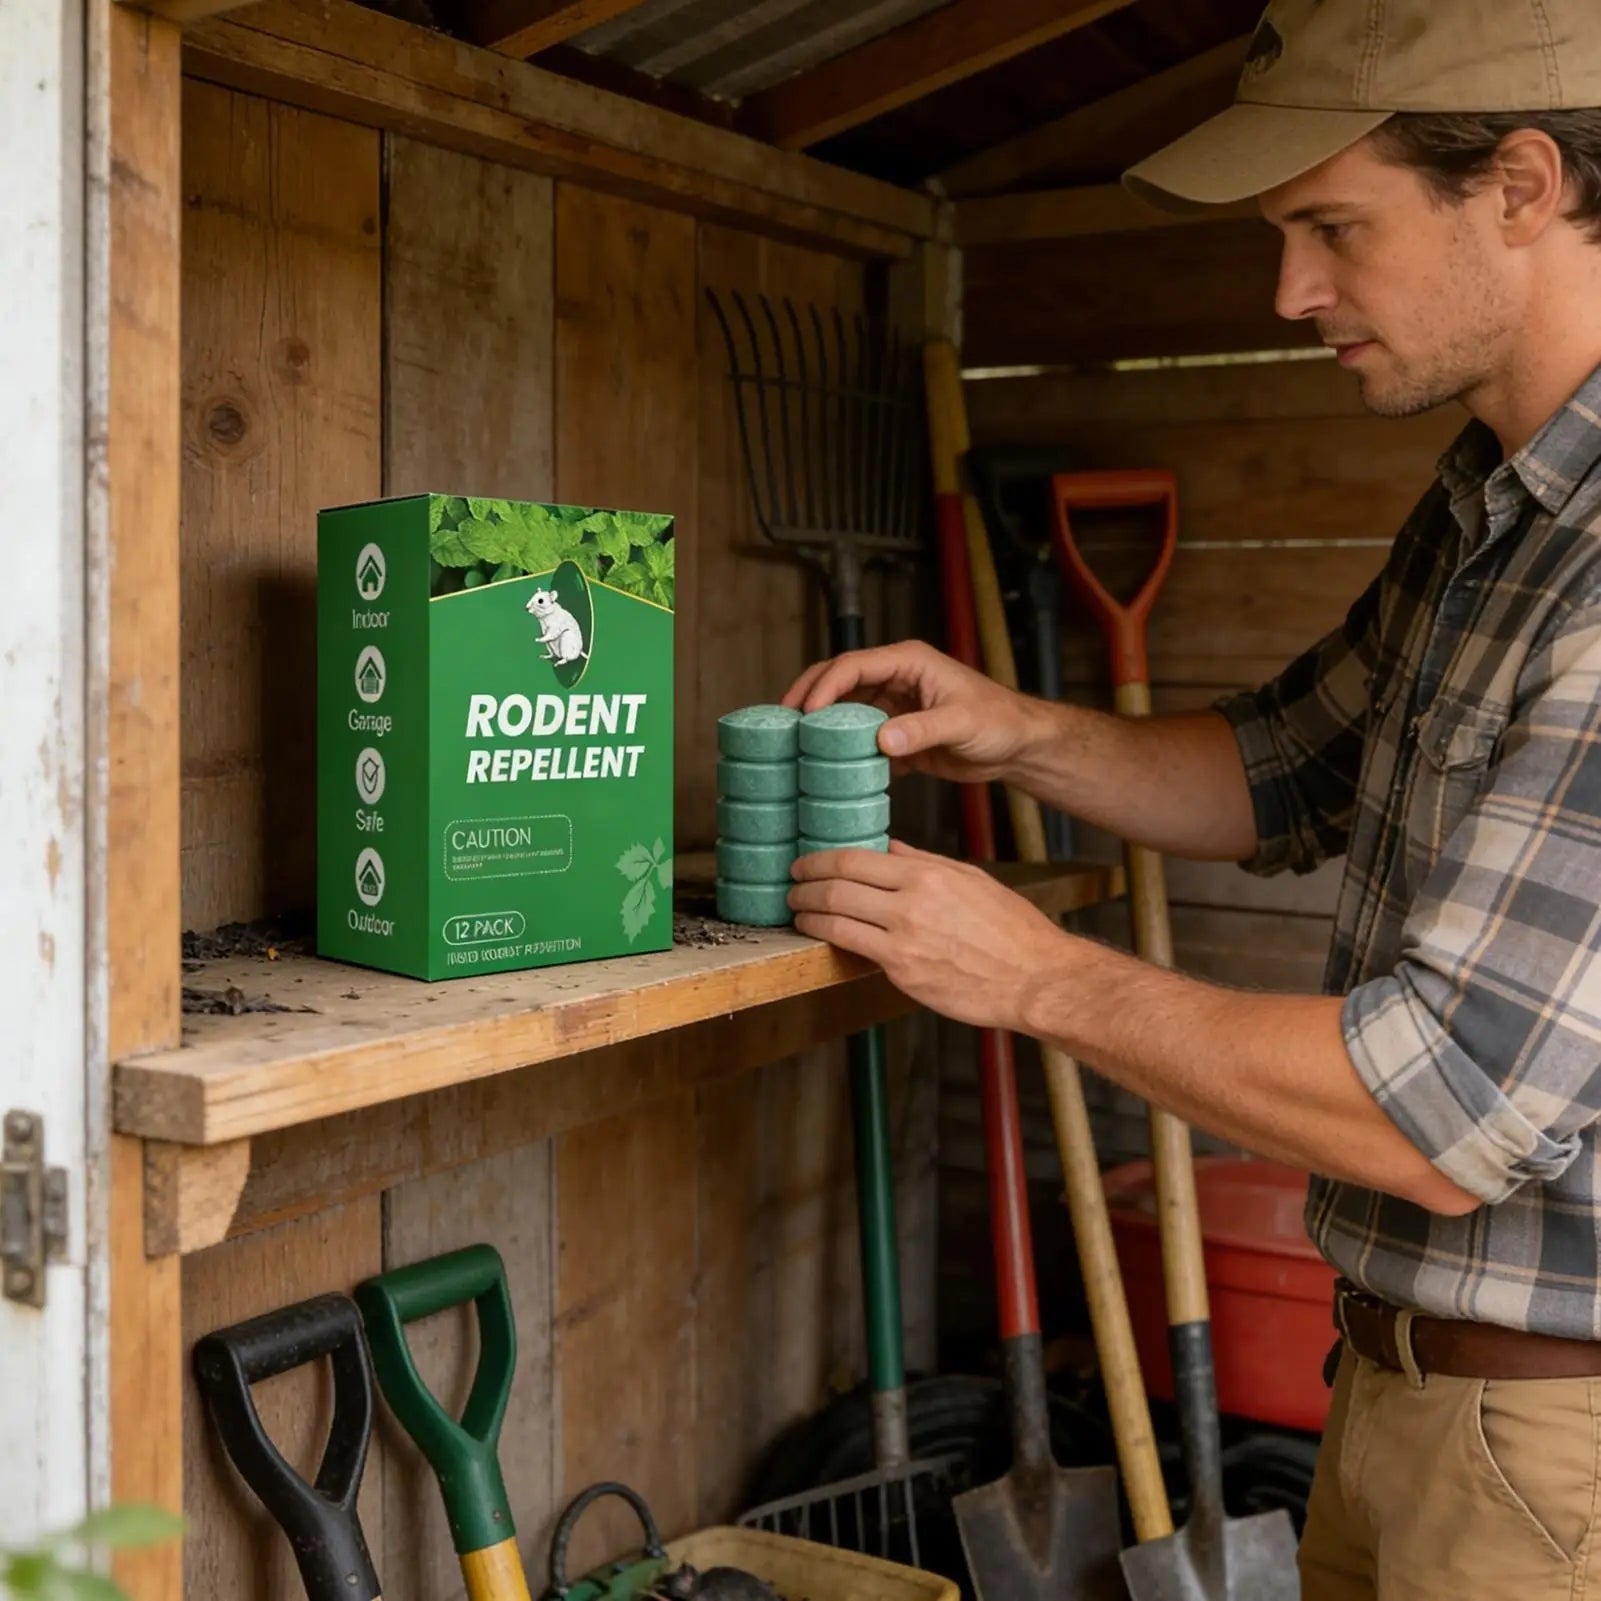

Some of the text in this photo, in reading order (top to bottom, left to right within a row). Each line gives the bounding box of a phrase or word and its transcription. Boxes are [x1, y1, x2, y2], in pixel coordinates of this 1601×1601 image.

[465, 693, 647, 738] RODENT
[466, 745, 645, 784] REPELLENT
[452, 827, 532, 850] CAUTION
[347, 908, 395, 936] Outdoor
[455, 917, 515, 940] 12 PACK
